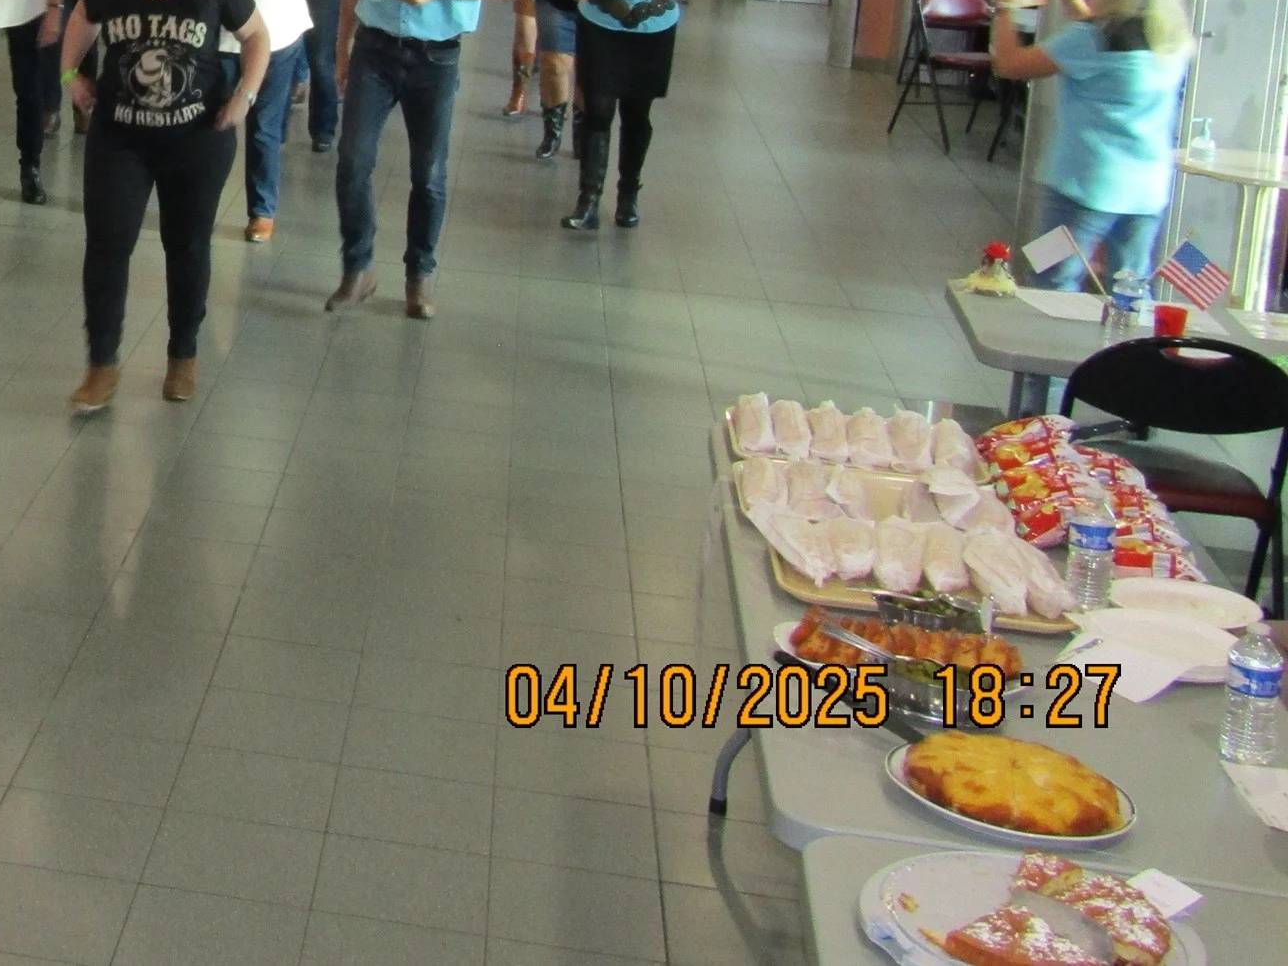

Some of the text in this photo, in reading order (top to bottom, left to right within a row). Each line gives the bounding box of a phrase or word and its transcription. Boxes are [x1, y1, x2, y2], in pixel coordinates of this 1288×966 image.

[107, 13, 208, 48] NO TAGS
[113, 101, 206, 127] NO RESTARTS
